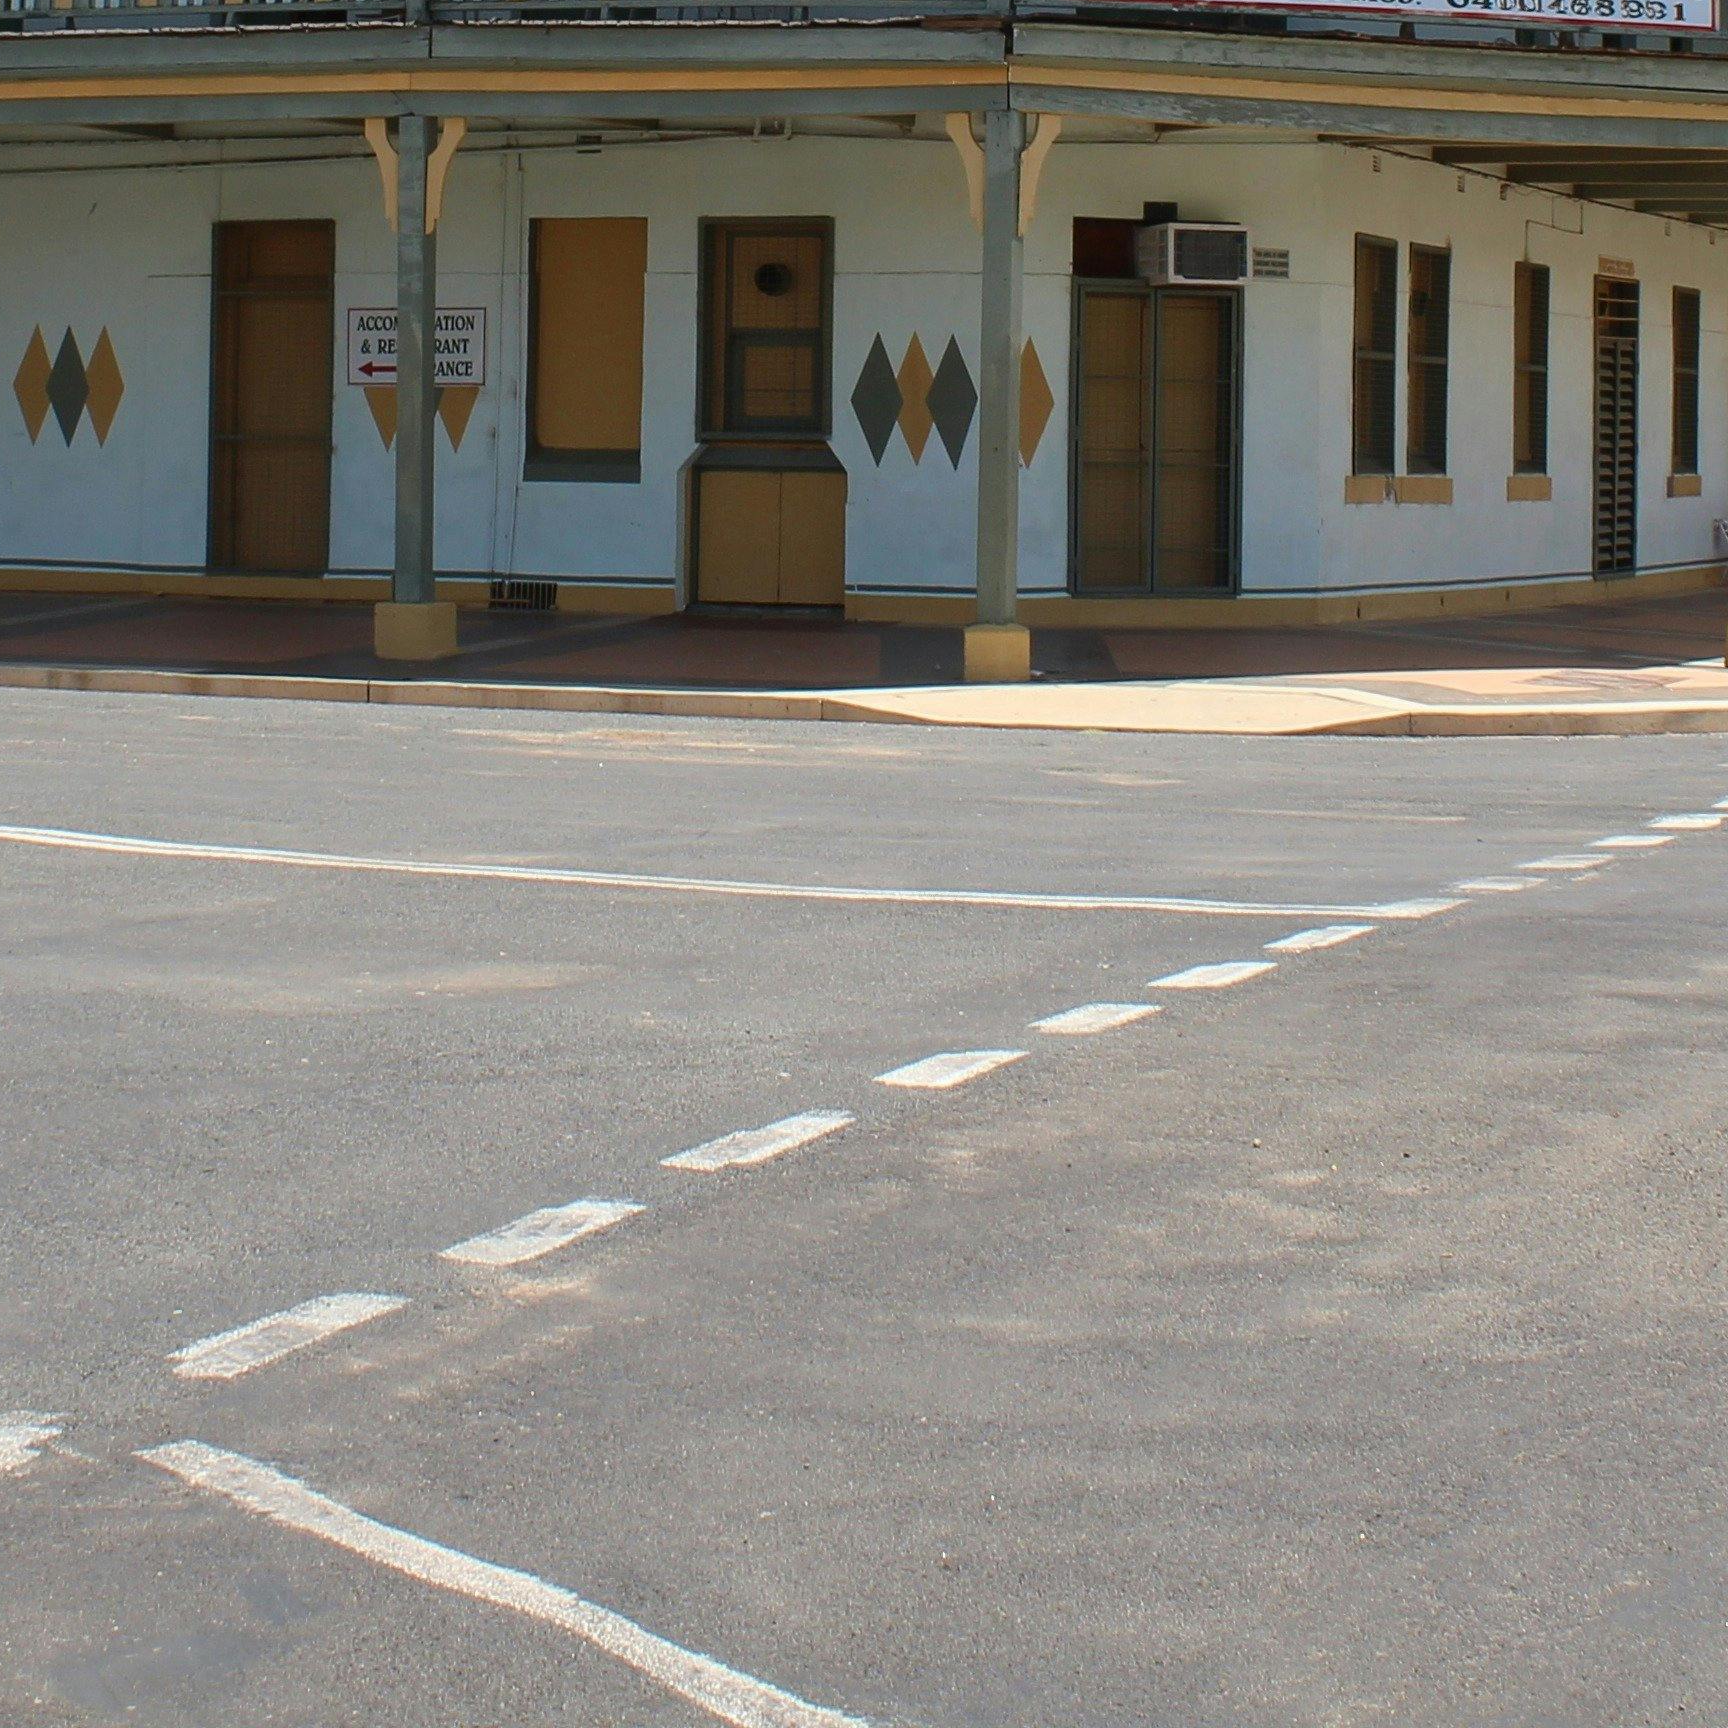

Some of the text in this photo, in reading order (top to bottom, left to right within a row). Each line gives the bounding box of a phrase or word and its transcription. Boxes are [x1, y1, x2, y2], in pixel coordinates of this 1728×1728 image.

[357, 315, 475, 331] ACCOATION
[360, 338, 470, 354] & RERANT
